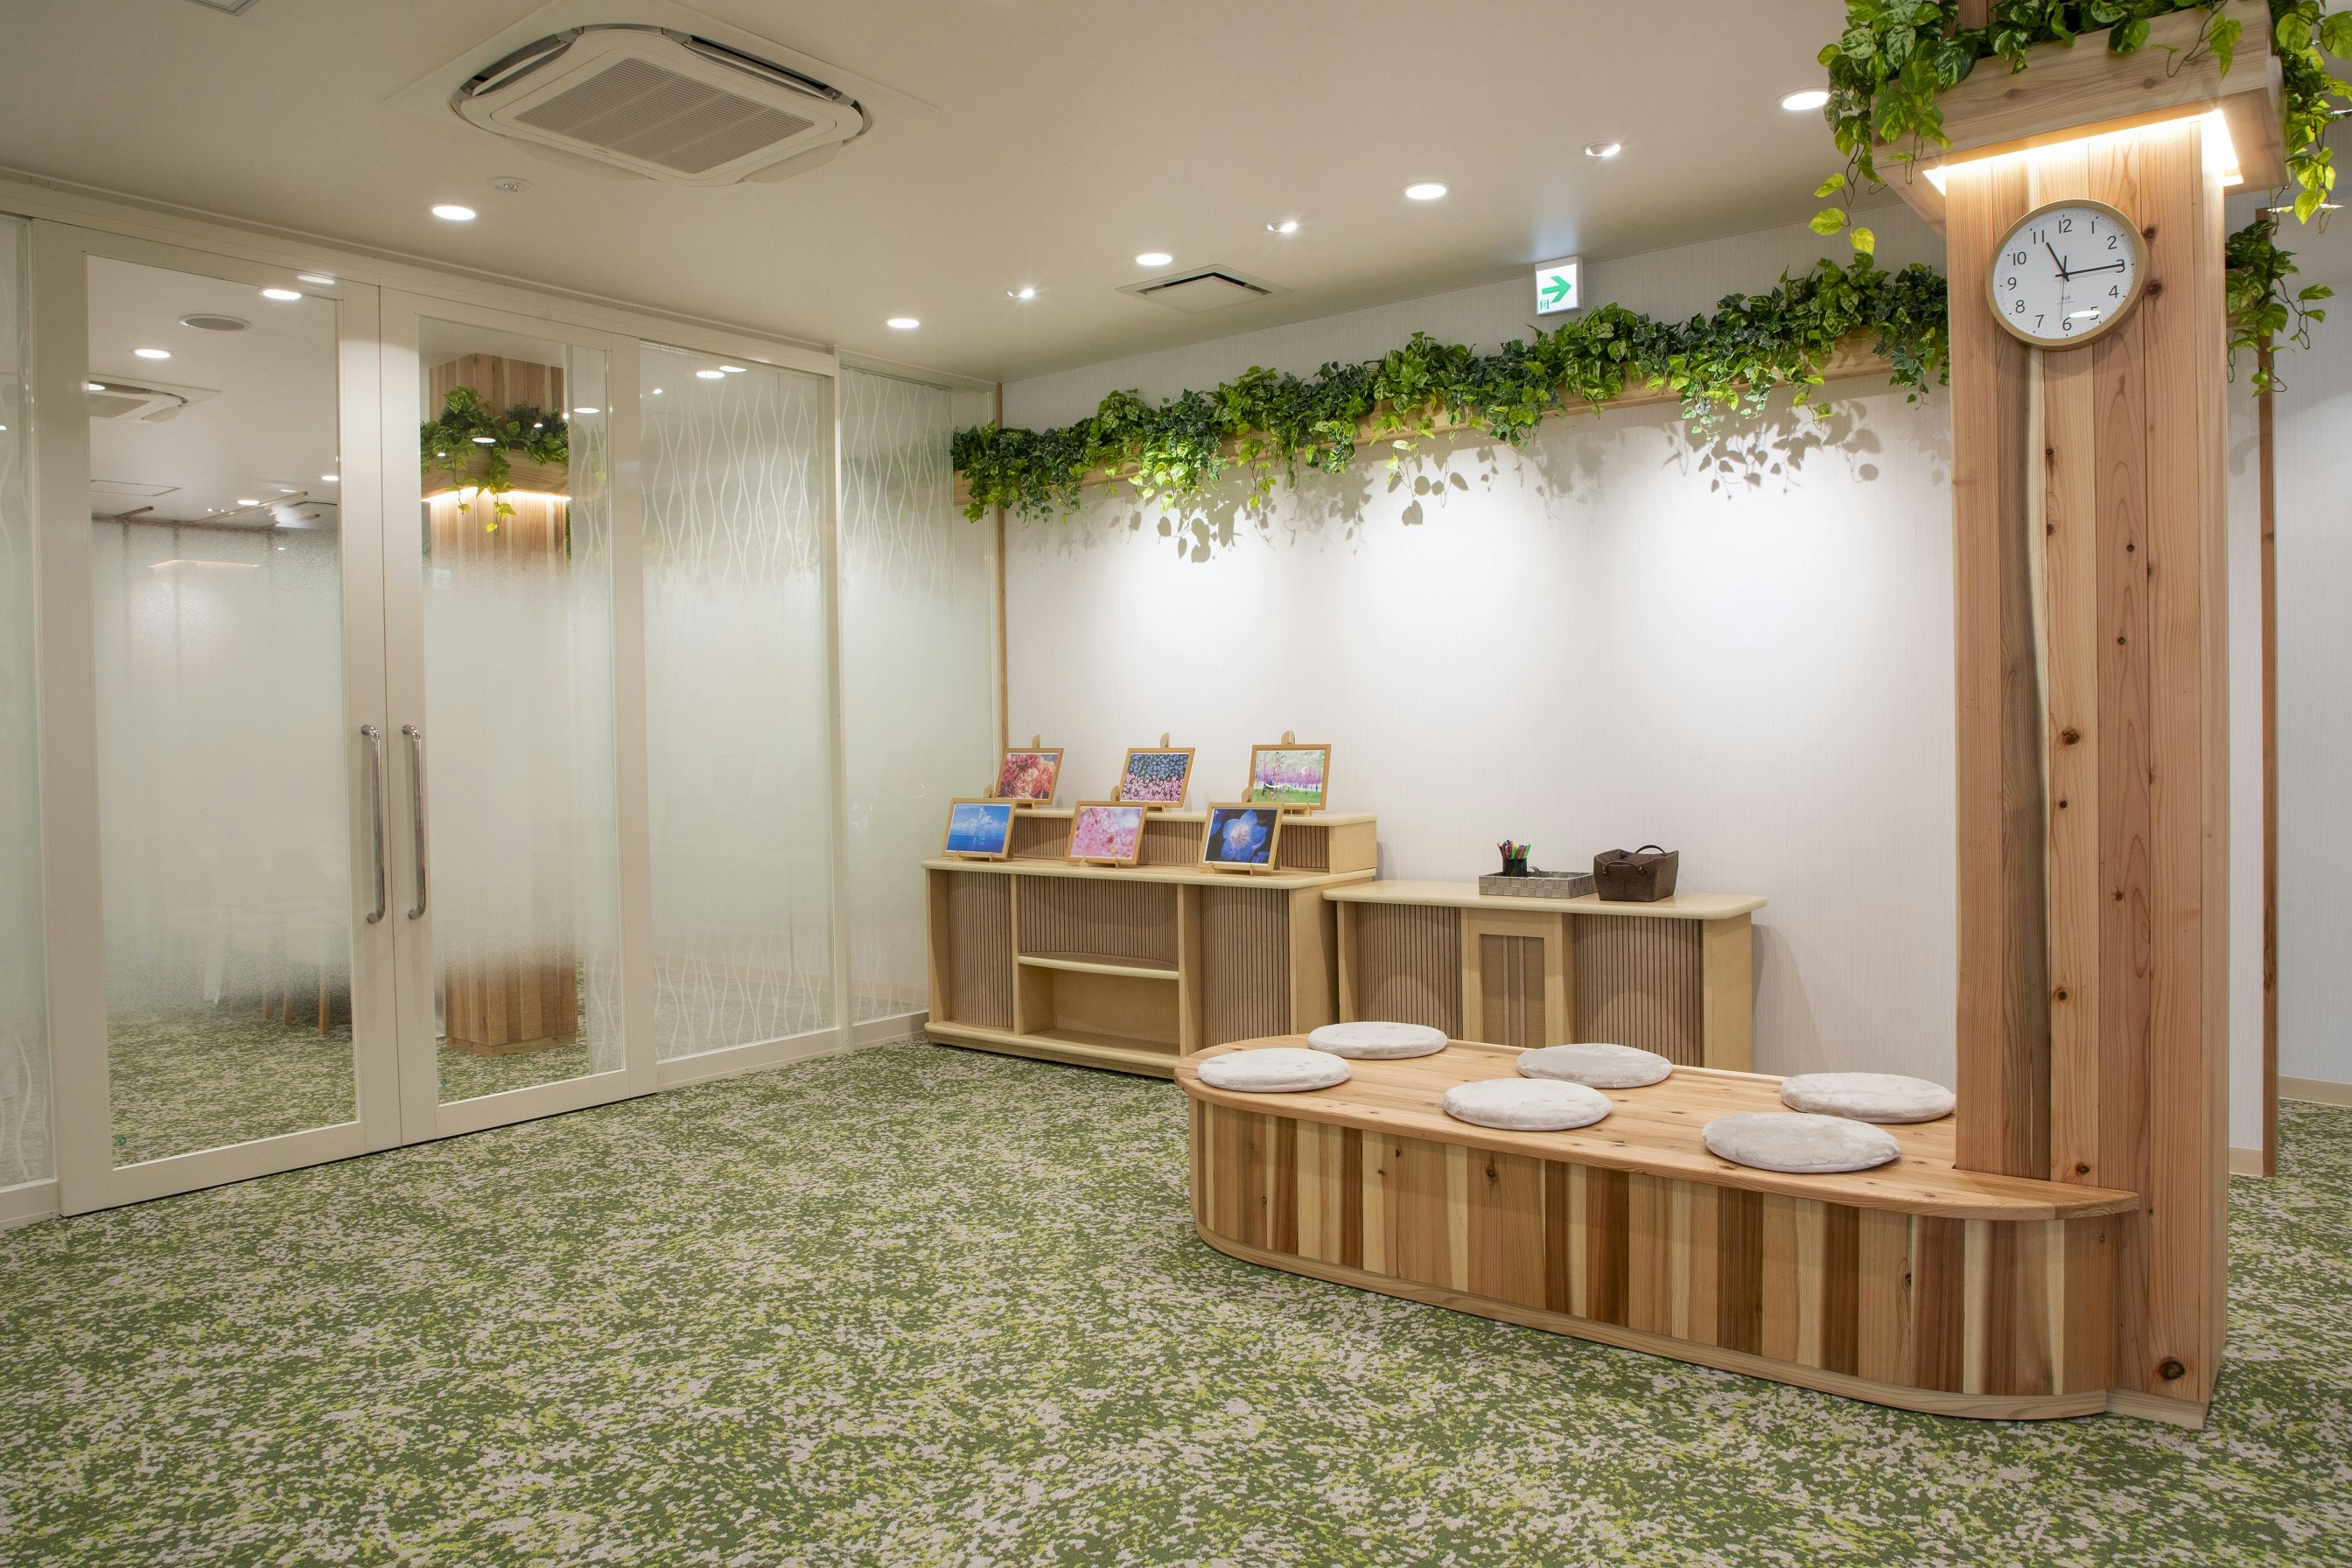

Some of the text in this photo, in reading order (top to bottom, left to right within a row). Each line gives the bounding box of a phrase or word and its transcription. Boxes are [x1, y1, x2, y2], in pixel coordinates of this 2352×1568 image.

[2058, 219, 2072, 234] 12
[2033, 229, 2045, 244] 11
[2107, 235, 2118, 250] 2
[2012, 251, 2026, 266] 10
[2116, 259, 2125, 273] 3
[2007, 276, 2017, 290] 9
[2108, 284, 2119, 298] 4
[2015, 299, 2026, 313] 8
[2035, 314, 2044, 328] 7
[2062, 317, 2072, 331] 6
